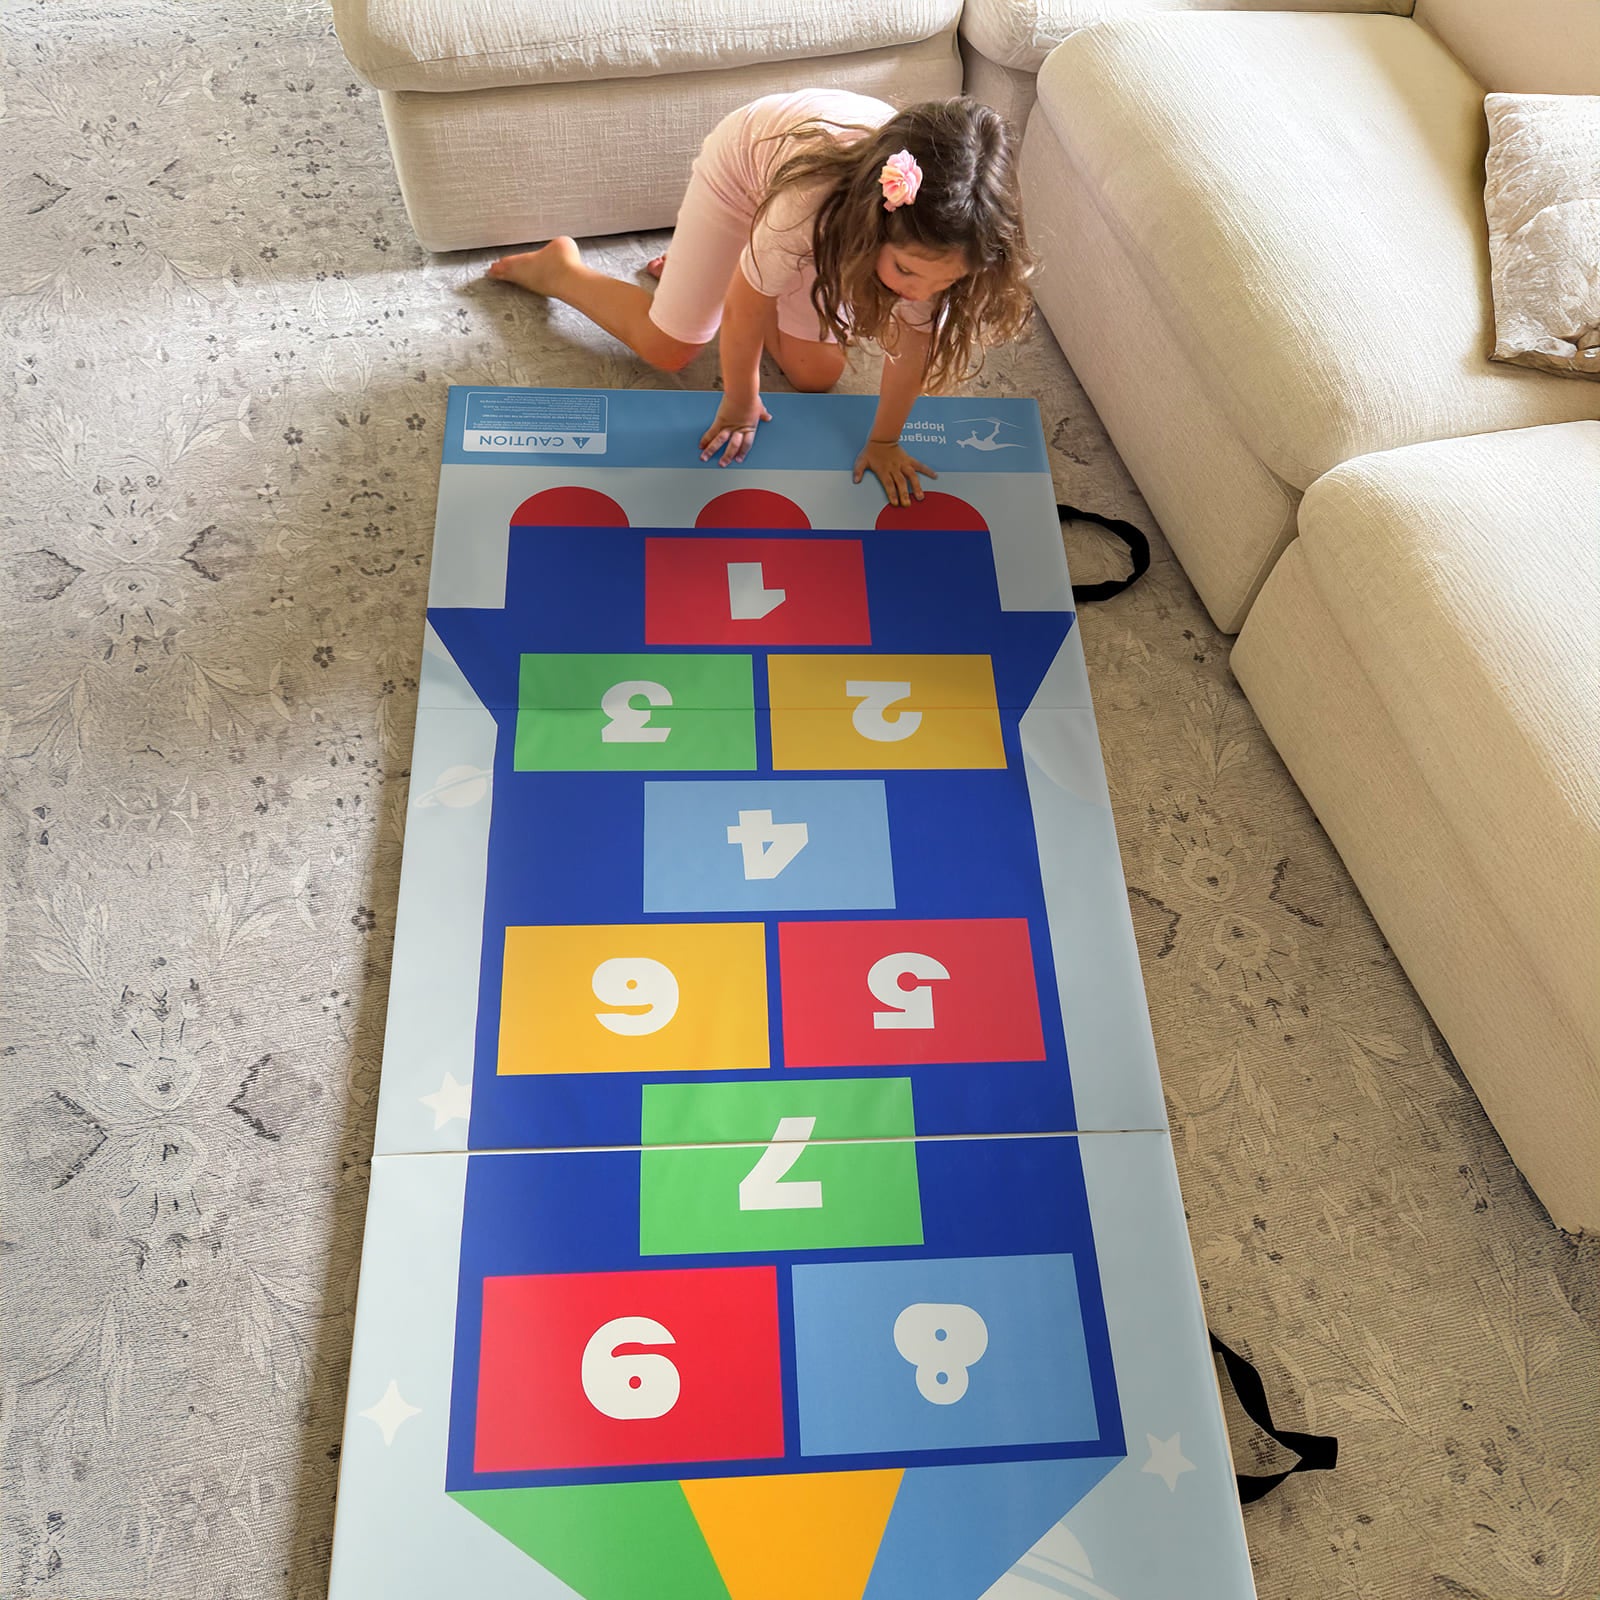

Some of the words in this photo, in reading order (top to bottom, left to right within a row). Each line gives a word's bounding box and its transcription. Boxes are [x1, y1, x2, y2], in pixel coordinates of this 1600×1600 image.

[480, 435, 564, 447] CAUTION
[898, 432, 946, 444] Kangaro
[727, 561, 786, 620] 1
[602, 681, 673, 743] 3
[846, 681, 922, 742] 2
[727, 809, 809, 881] 4
[592, 958, 679, 1036] 6
[867, 952, 950, 1030] 5
[739, 1117, 823, 1211] 7
[581, 1316, 680, 1420] 9
[893, 1303, 989, 1405] 8
